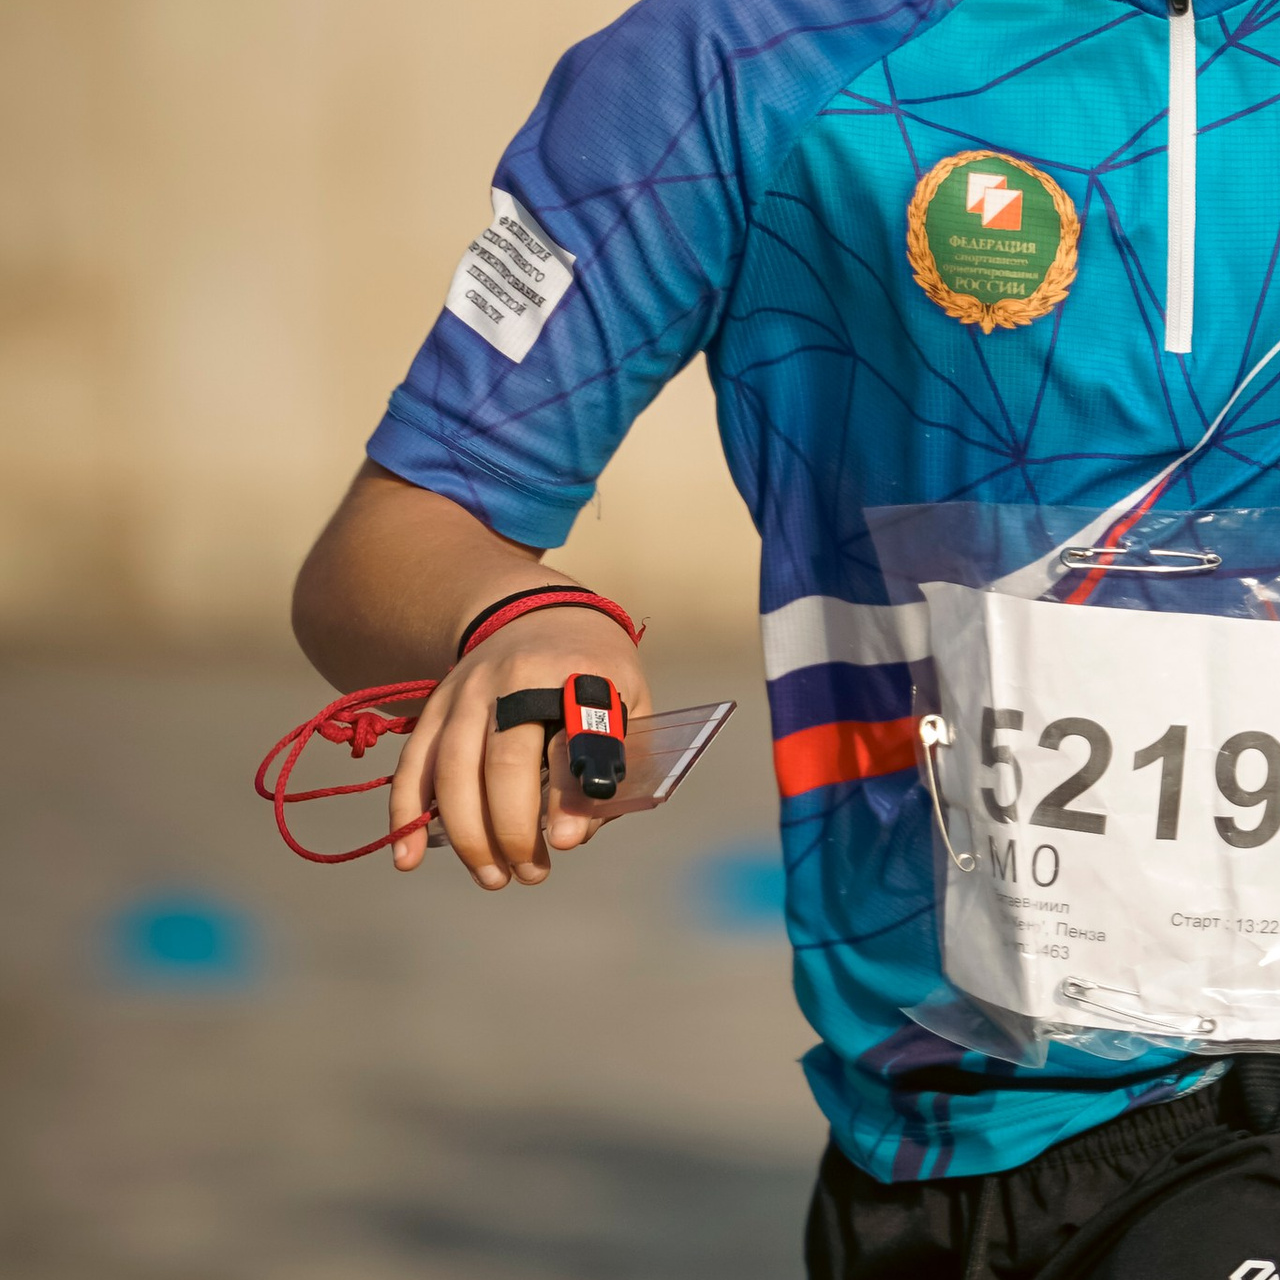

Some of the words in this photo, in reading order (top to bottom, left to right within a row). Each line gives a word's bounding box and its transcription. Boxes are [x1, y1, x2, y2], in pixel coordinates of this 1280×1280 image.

[499, 216, 553, 262] ФЕДЕРАЦИЯ
[949, 235, 1036, 254] ФЕДЕРАЦИЯ
[468, 240, 547, 308] РИЕНТИРОВАНИЯ
[955, 276, 1025, 295] РОССИИ
[1171, 912, 1221, 931] Старт
[1055, 922, 1106, 942] Пенза
